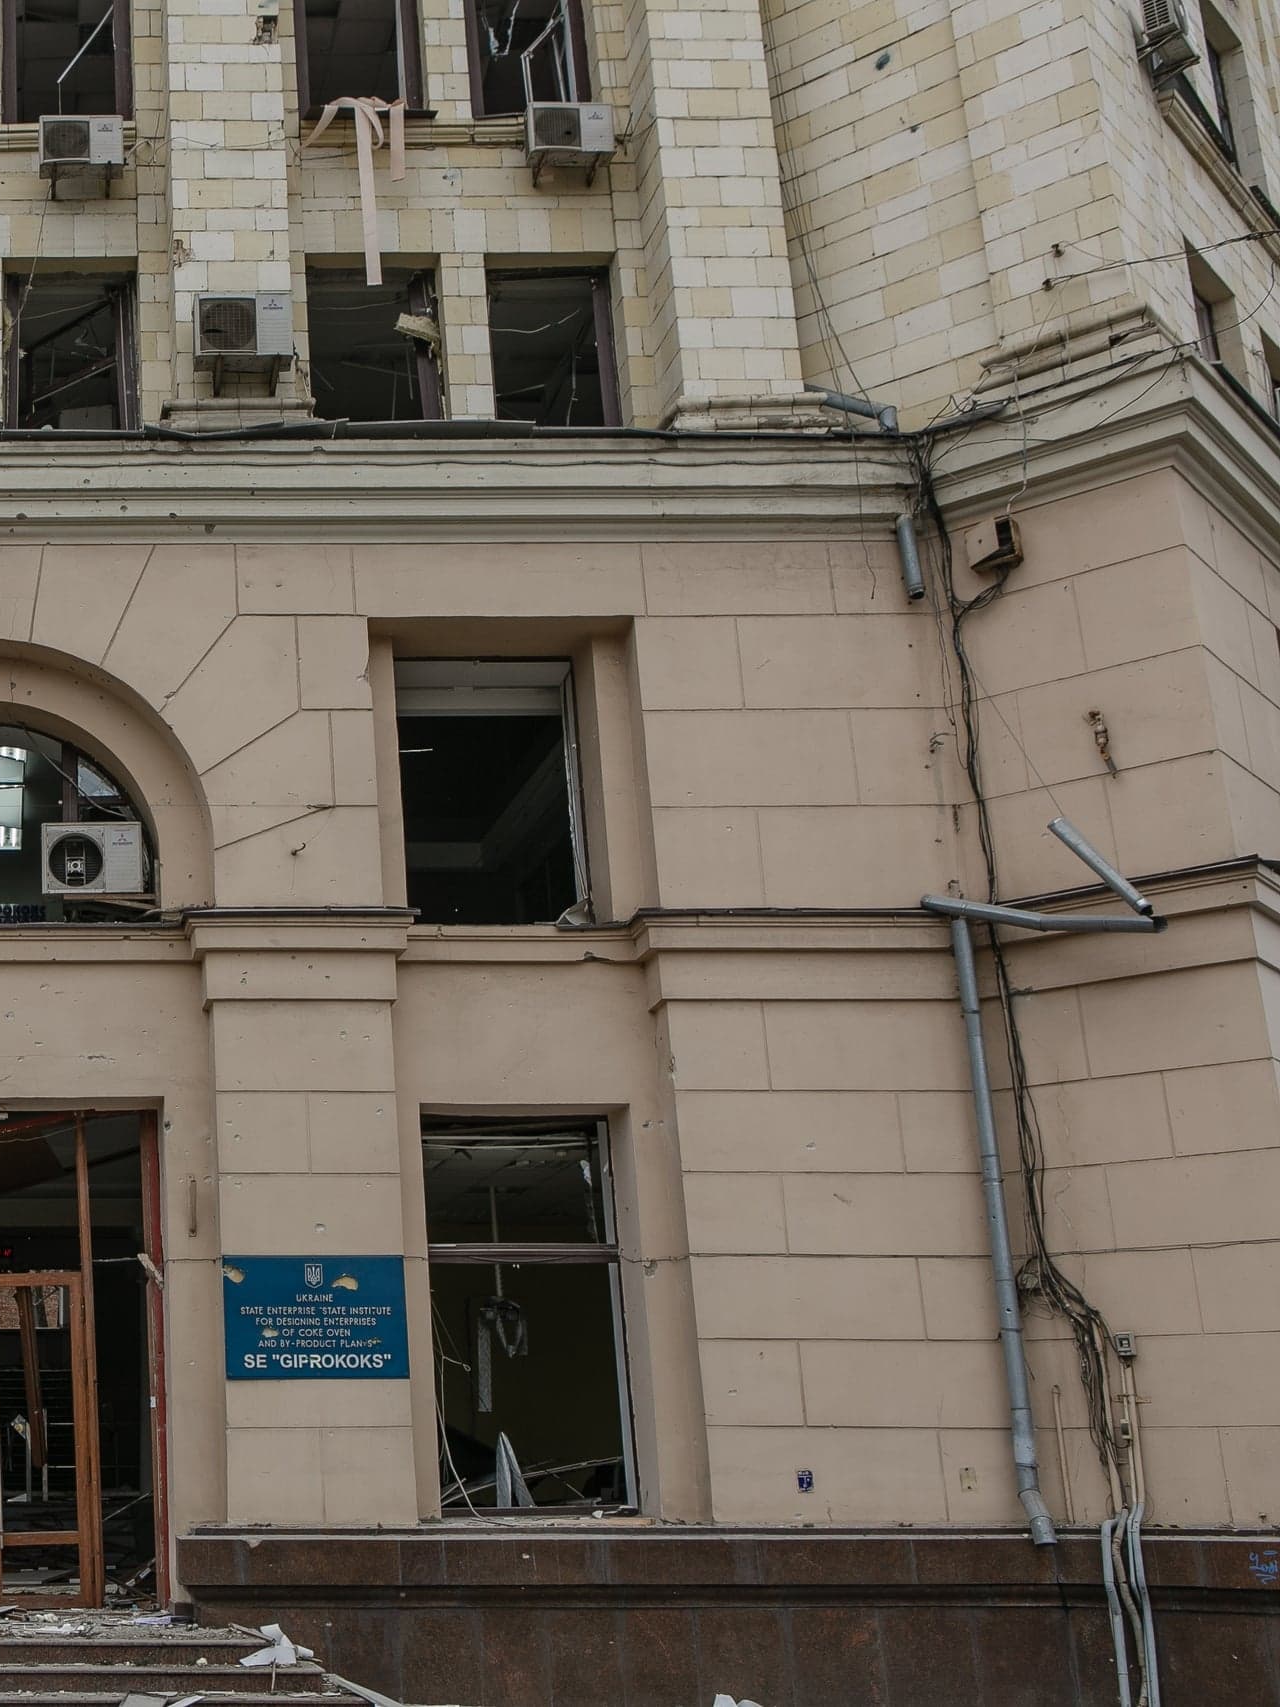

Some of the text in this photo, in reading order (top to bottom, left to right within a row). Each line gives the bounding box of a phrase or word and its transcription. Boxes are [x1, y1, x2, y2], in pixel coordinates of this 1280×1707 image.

[296, 1294, 334, 1302] UKRAINE
[240, 1306, 263, 1315] STATE
[267, 1306, 316, 1315] ENTERPRISE
[350, 1306, 392, 1315] INSTITUTE
[256, 1317, 377, 1326] FOR DESIGNING ENTERPRISES
[282, 1328, 351, 1337] OF COKE OVEN
[258, 1339, 277, 1348] AND
[280, 1339, 336, 1348] BY-PRODUCT
[244, 1353, 392, 1369] SE "GIPROKOKS"
